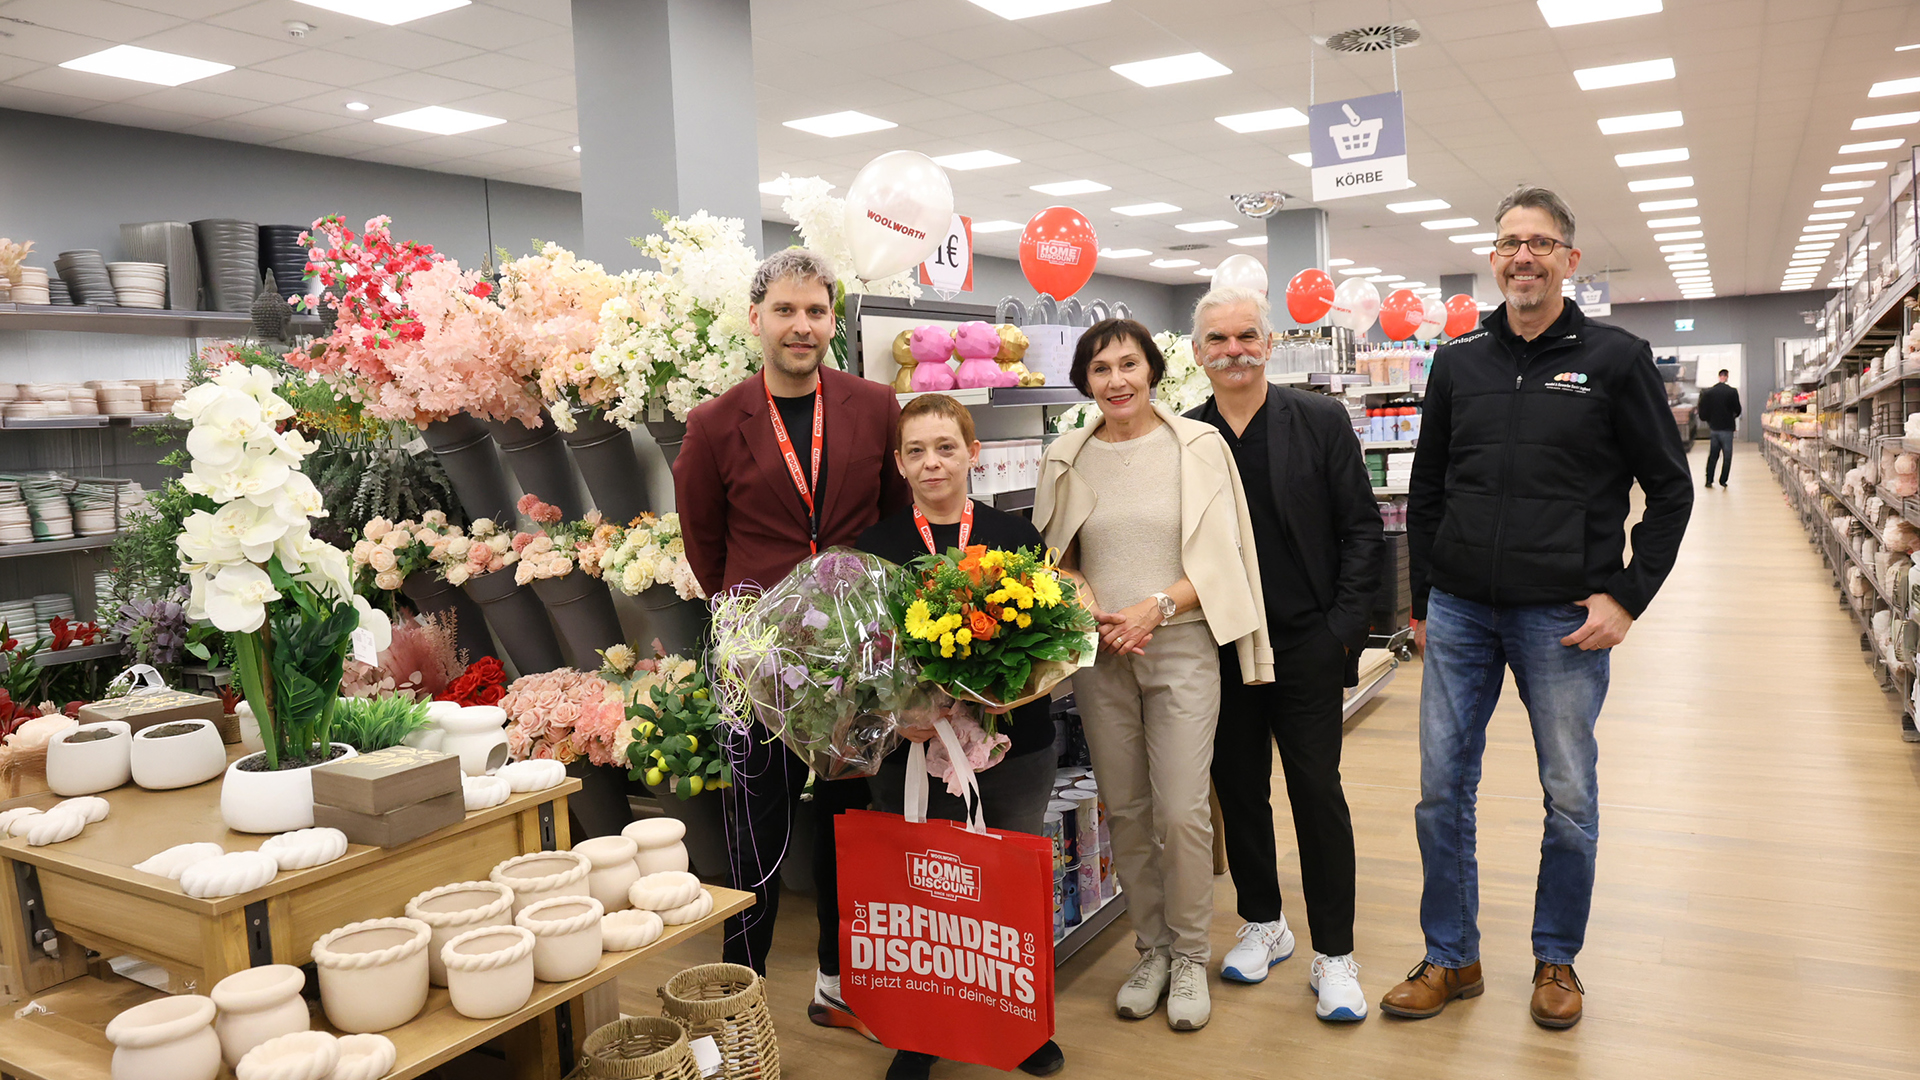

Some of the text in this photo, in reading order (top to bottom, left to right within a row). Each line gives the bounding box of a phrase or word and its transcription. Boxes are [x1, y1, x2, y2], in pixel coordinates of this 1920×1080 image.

[1336, 171, 1383, 187] KÖRBE
[867, 209, 926, 240] WOOLWORTH
[1040, 253, 1076, 262] DISCOUNT
[1041, 244, 1077, 258] HOME
[1449, 331, 1489, 346] uhlsport
[815, 396, 823, 435] WOOLWORTH
[787, 453, 806, 493] WOOLWORTH
[914, 857, 975, 886] HOME
[931, 853, 958, 863] WOOLWORTH
[913, 875, 975, 896] DISCOUNT
[851, 900, 1036, 967] Der ERFINDER des
[851, 935, 1036, 1004] DISCOUNTS
[851, 972, 1037, 1022] ist jetzt auch in deiner Stadt!
